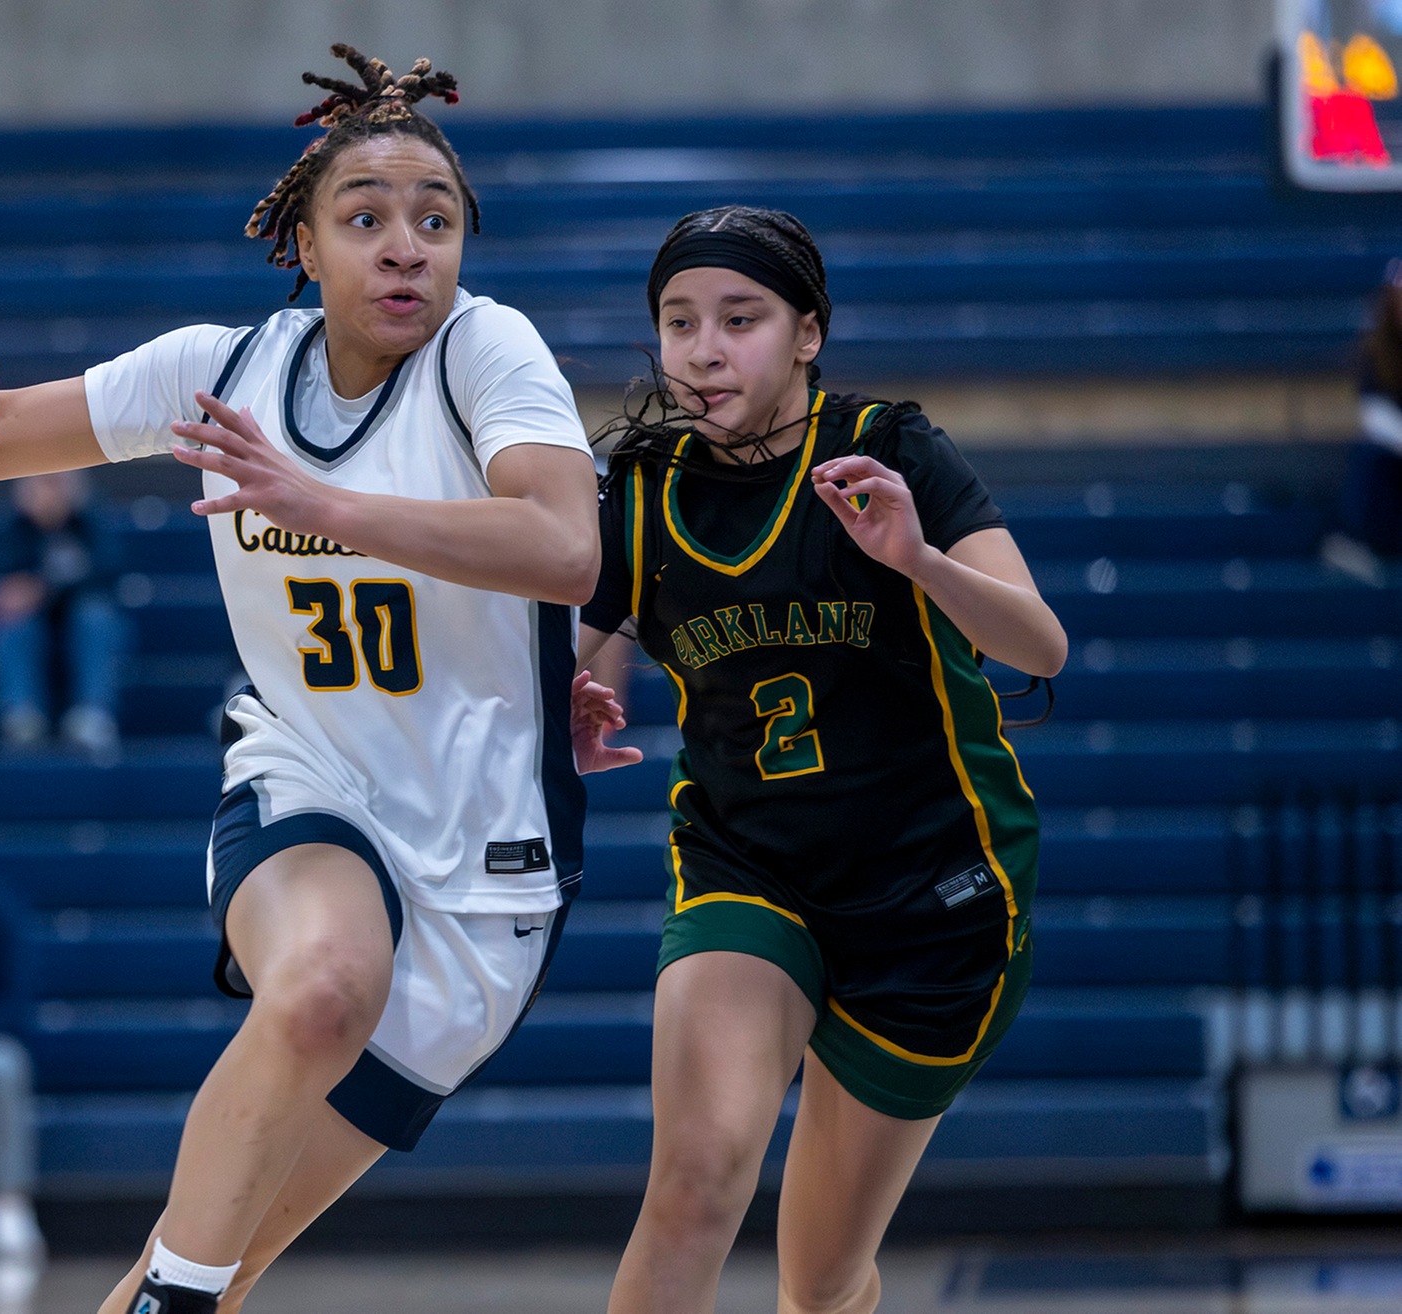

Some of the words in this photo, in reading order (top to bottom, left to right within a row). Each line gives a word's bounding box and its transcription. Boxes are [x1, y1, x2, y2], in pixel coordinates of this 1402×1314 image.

[284, 576, 424, 697] 30
[671, 601, 875, 670] PARKLAND
[749, 672, 825, 781] 2
[532, 848, 540, 861] L
[974, 872, 988, 885] M
